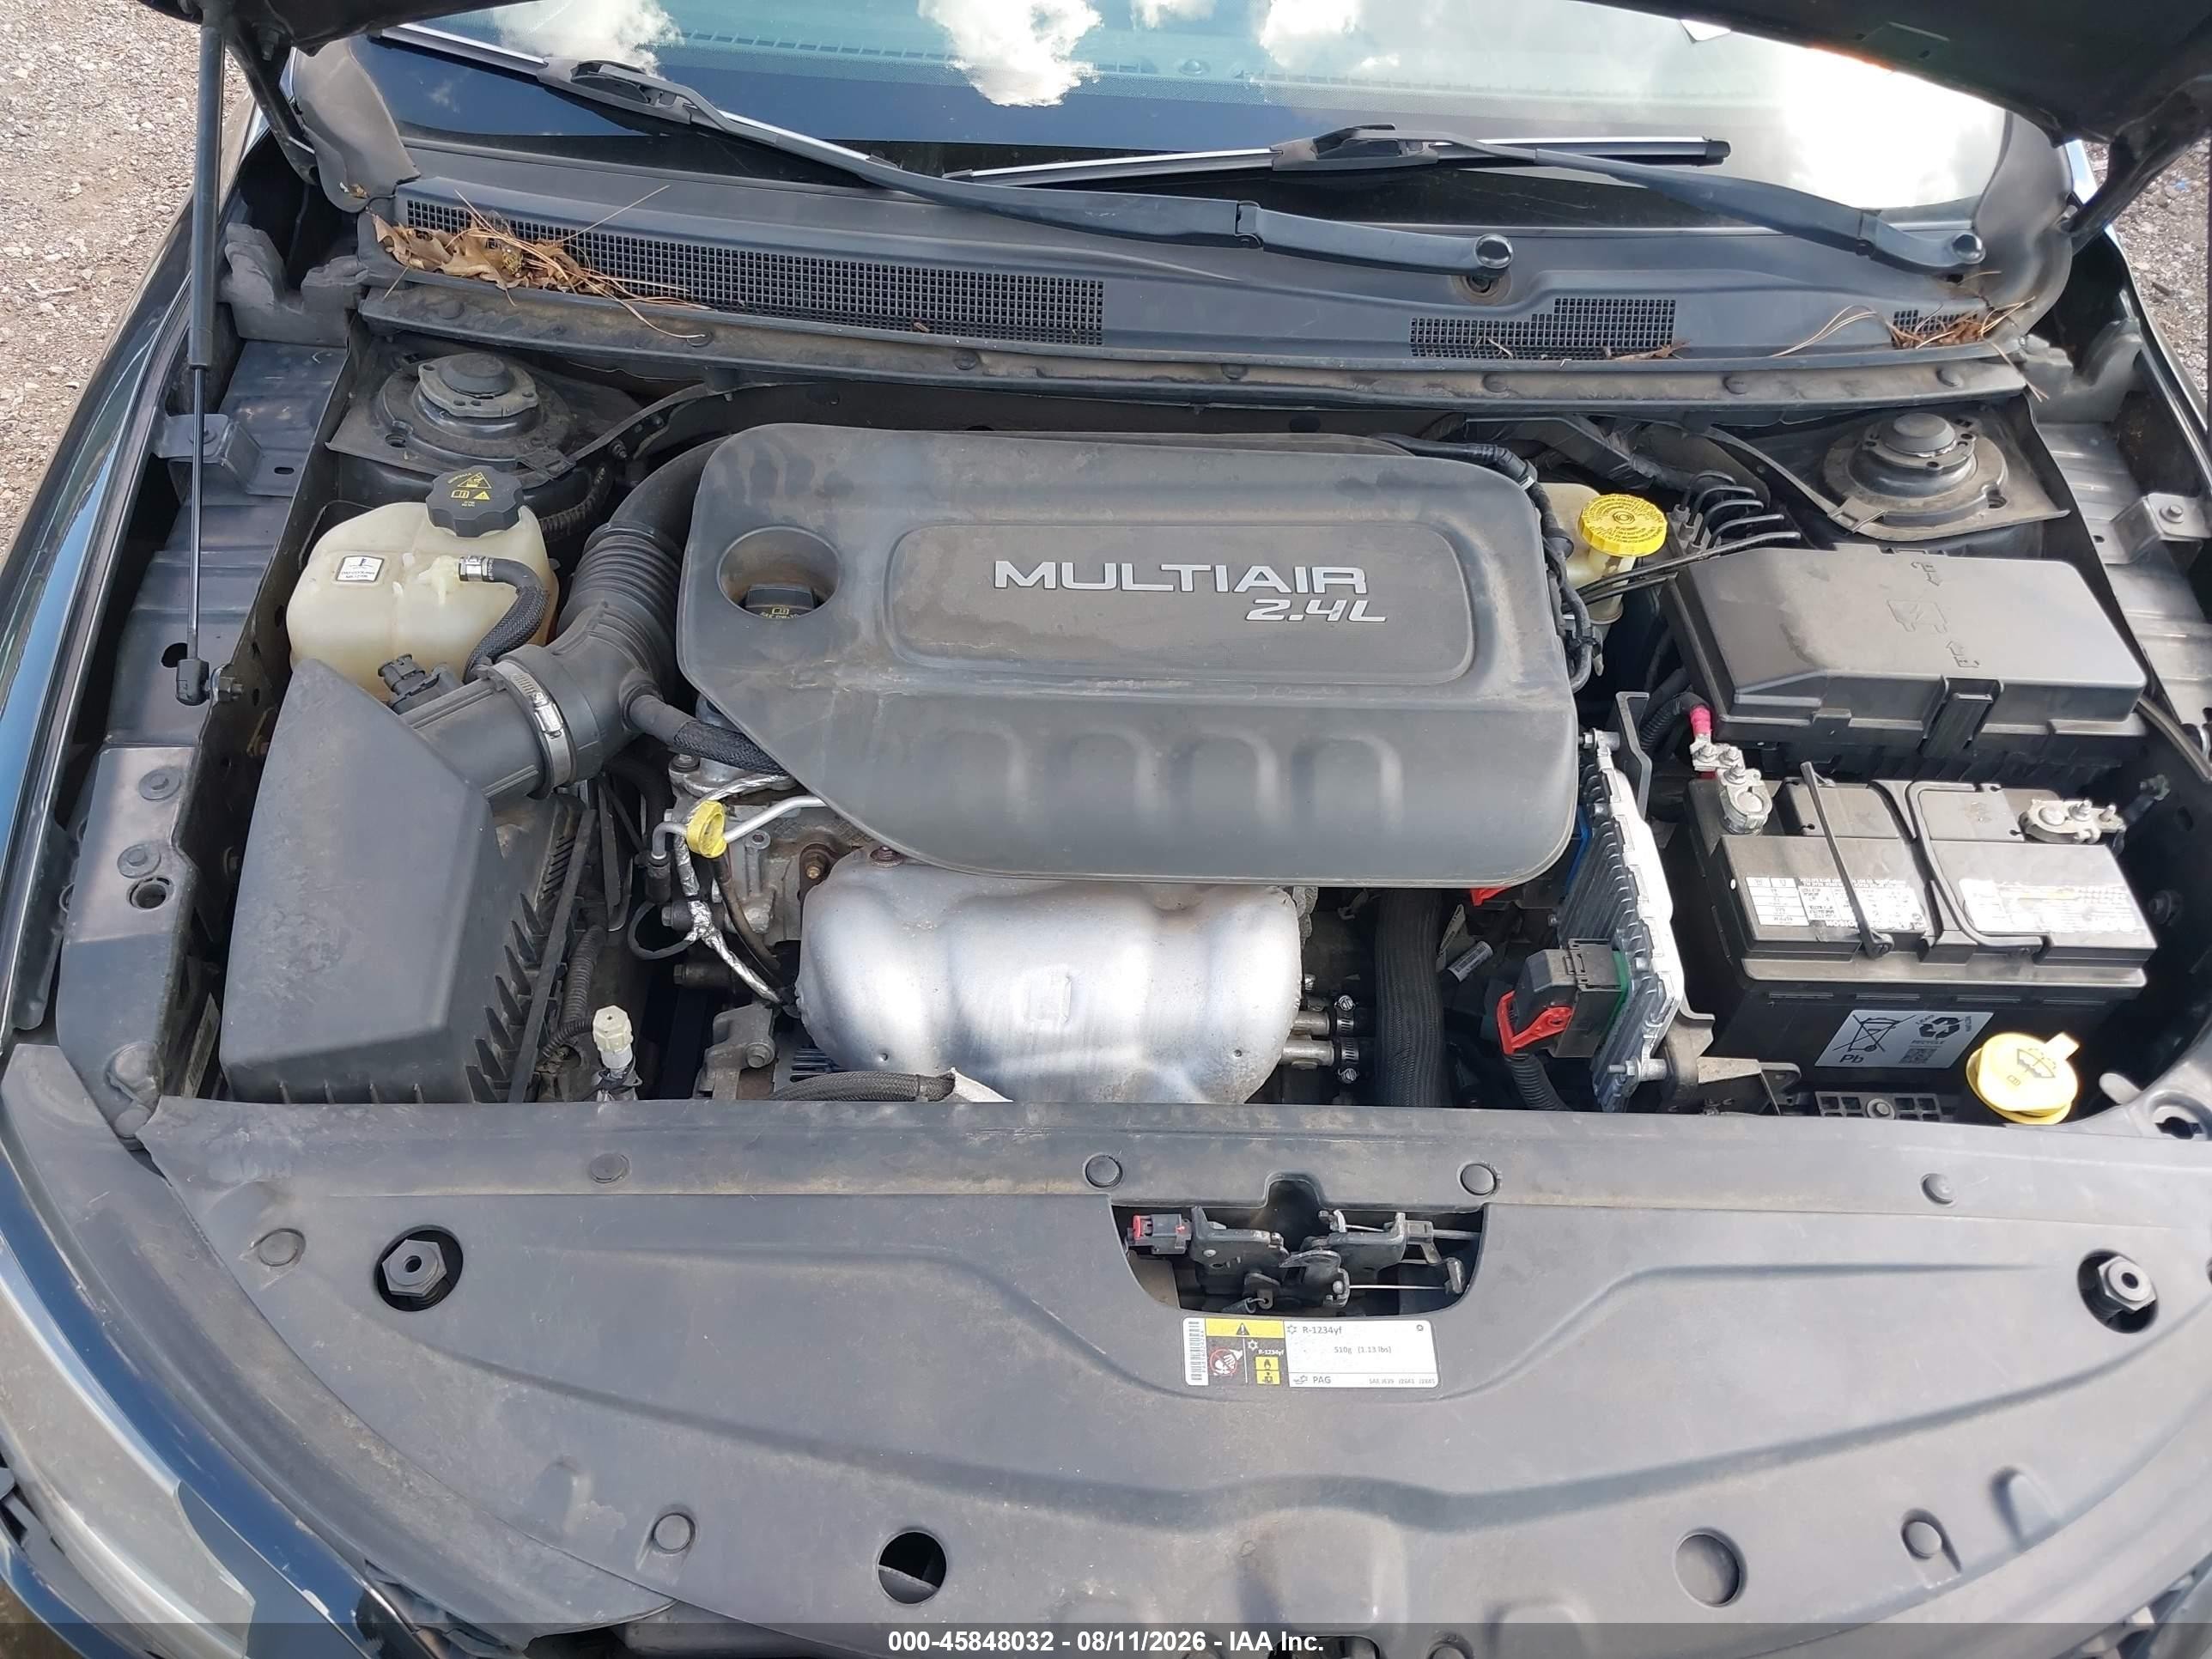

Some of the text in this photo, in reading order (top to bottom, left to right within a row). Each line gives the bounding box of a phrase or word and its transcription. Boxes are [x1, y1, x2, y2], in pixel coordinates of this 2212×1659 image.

[993, 560, 1368, 595] MULTIAIR
[1245, 598, 1388, 623] 2.4L
[1838, 1054, 1864, 1064] Pb
[1302, 1326, 1342, 1335] R-1234yf
[1312, 1376, 1332, 1384] PAG
